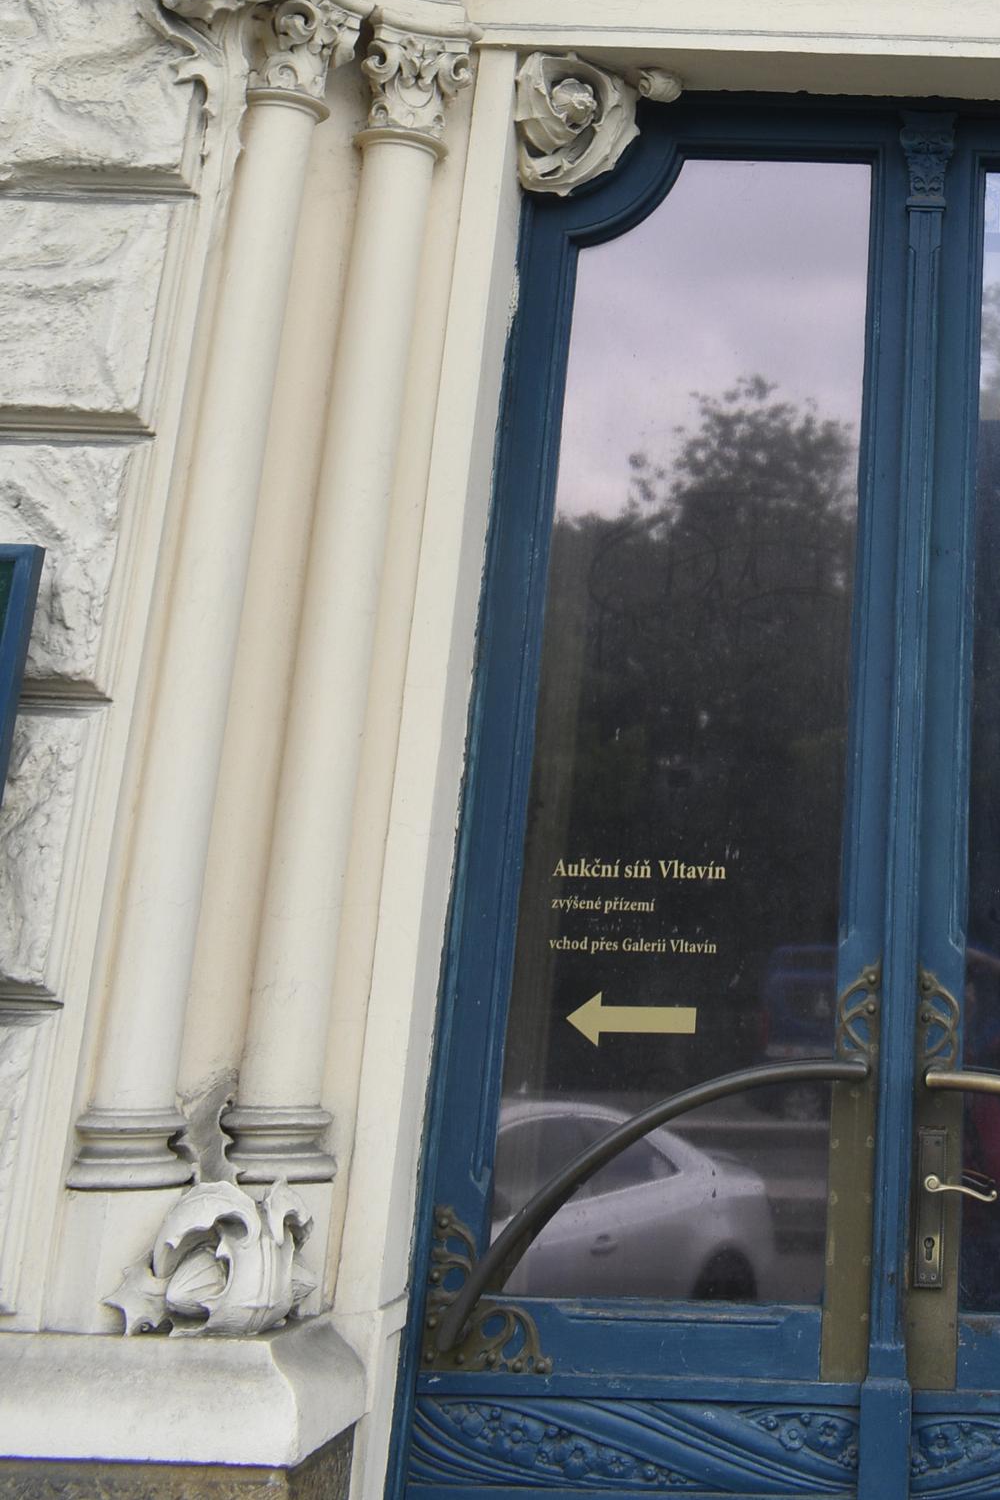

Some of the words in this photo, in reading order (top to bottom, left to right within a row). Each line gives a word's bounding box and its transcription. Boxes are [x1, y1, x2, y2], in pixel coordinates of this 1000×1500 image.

[552, 858, 620, 878] Aukční
[624, 859, 651, 879] síň
[658, 860, 726, 880] Vltavín
[551, 895, 601, 913] zvýšené
[604, 897, 656, 914] přízemí
[549, 936, 588, 950] vchod
[591, 937, 618, 954] přes
[622, 938, 666, 953] Galerii
[670, 939, 717, 954] Vltavín
